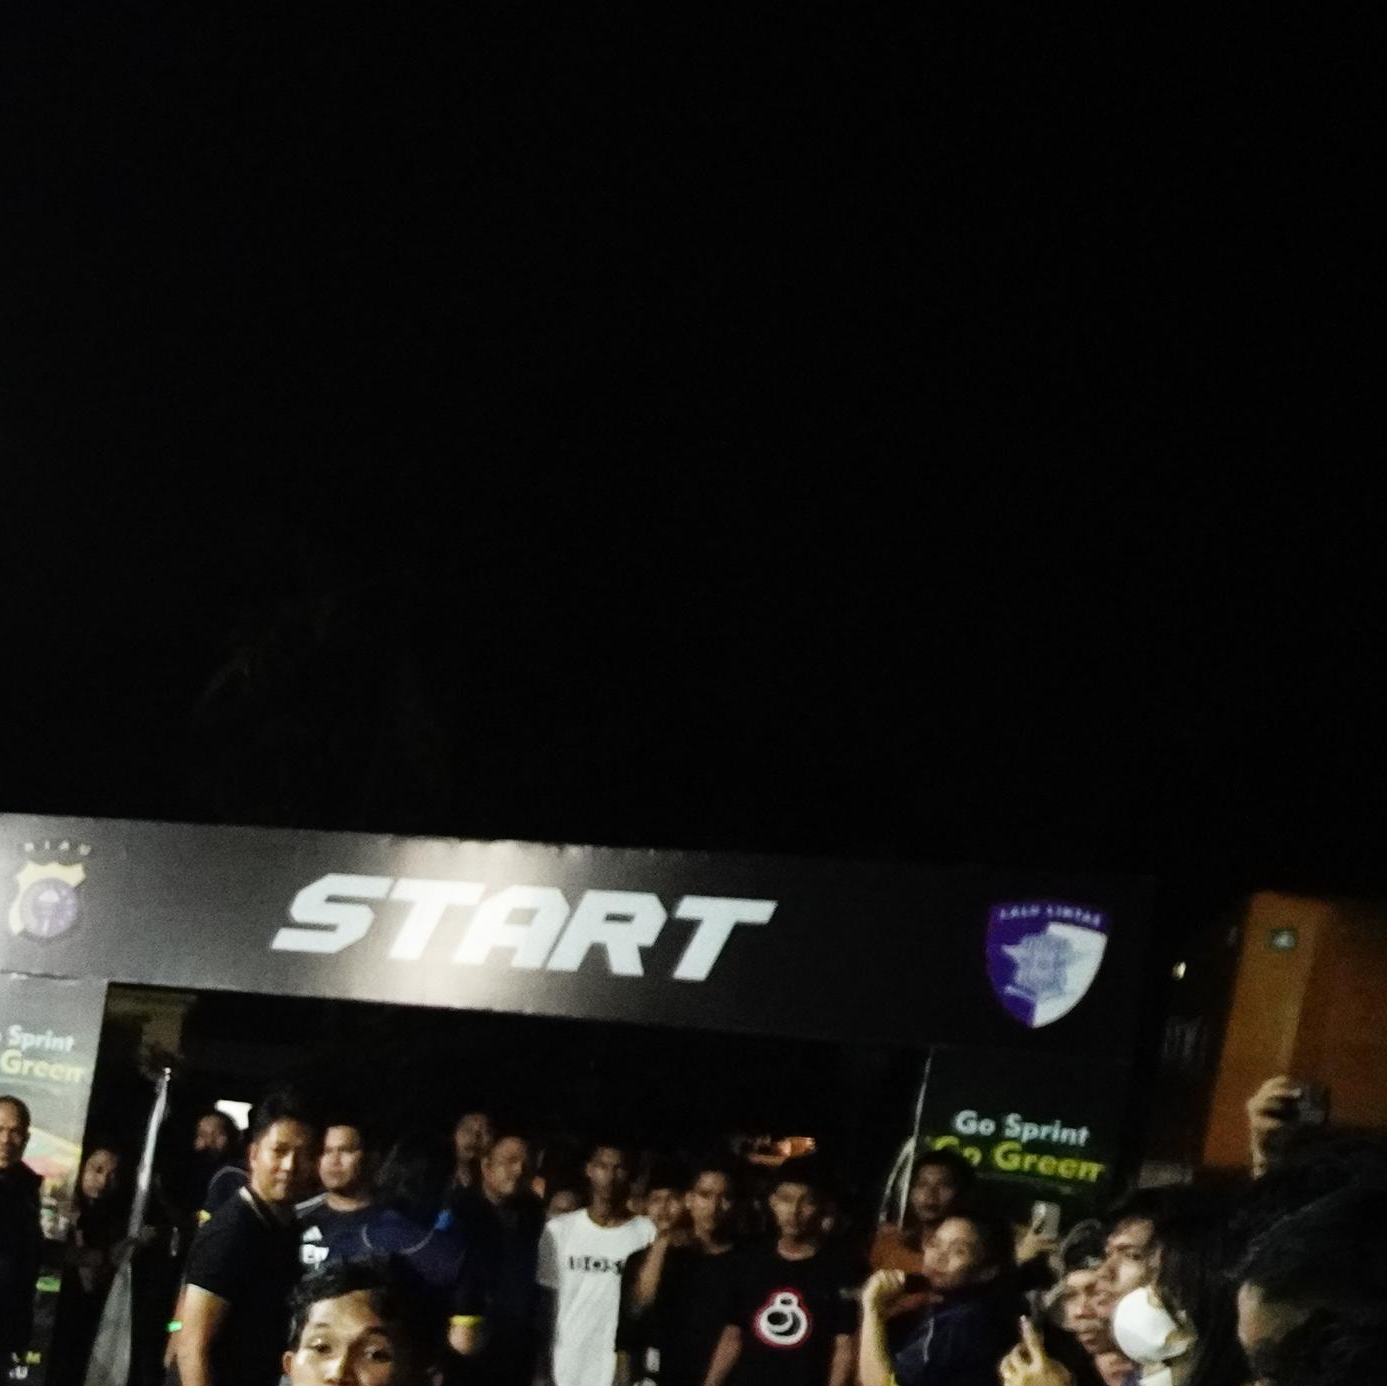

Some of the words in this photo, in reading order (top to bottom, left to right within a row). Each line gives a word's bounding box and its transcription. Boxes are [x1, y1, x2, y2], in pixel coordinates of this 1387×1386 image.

[270, 873, 779, 981] START
[7, 1024, 75, 1053] Sprint
[0, 1048, 85, 1082] Green
[954, 1109, 997, 1136] Go
[1004, 1112, 1090, 1147] Sprint
[993, 1140, 1107, 1183] Green
